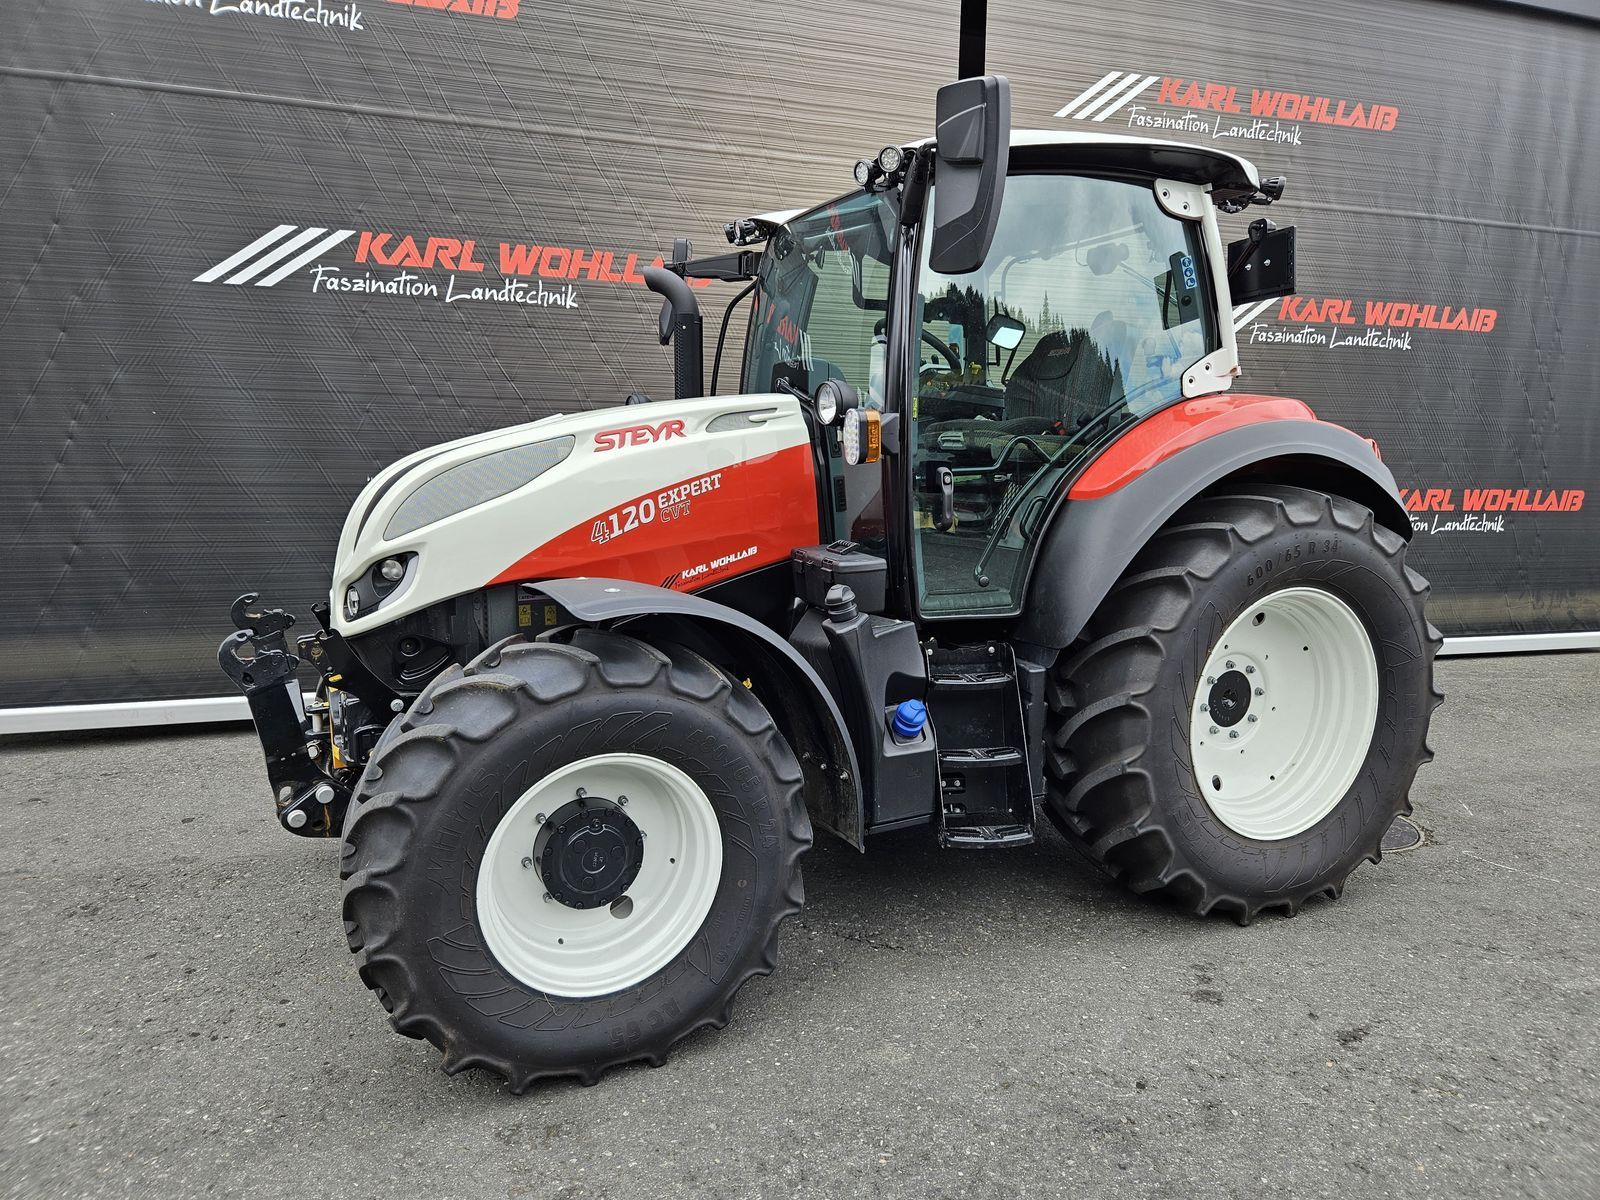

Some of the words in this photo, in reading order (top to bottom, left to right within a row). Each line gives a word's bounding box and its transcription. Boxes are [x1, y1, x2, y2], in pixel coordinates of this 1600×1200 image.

[1158, 78, 1240, 113] KARL
[1127, 103, 1209, 134] Faszination
[1212, 114, 1303, 145] Landtechnik
[355, 231, 485, 272] KARL
[310, 264, 438, 297] Faszination
[445, 274, 579, 309] Landtechnik
[1278, 296, 1356, 324] KARL
[1249, 322, 1326, 346] Faszination
[1329, 327, 1412, 351] Landtechnik
[593, 419, 687, 453] STEYR
[591, 499, 656, 545] 4120
[657, 473, 722, 509] EXPERT
[660, 500, 691, 523] CVT
[1430, 513, 1505, 535] Landtechnik
[681, 563, 709, 580] KARL
